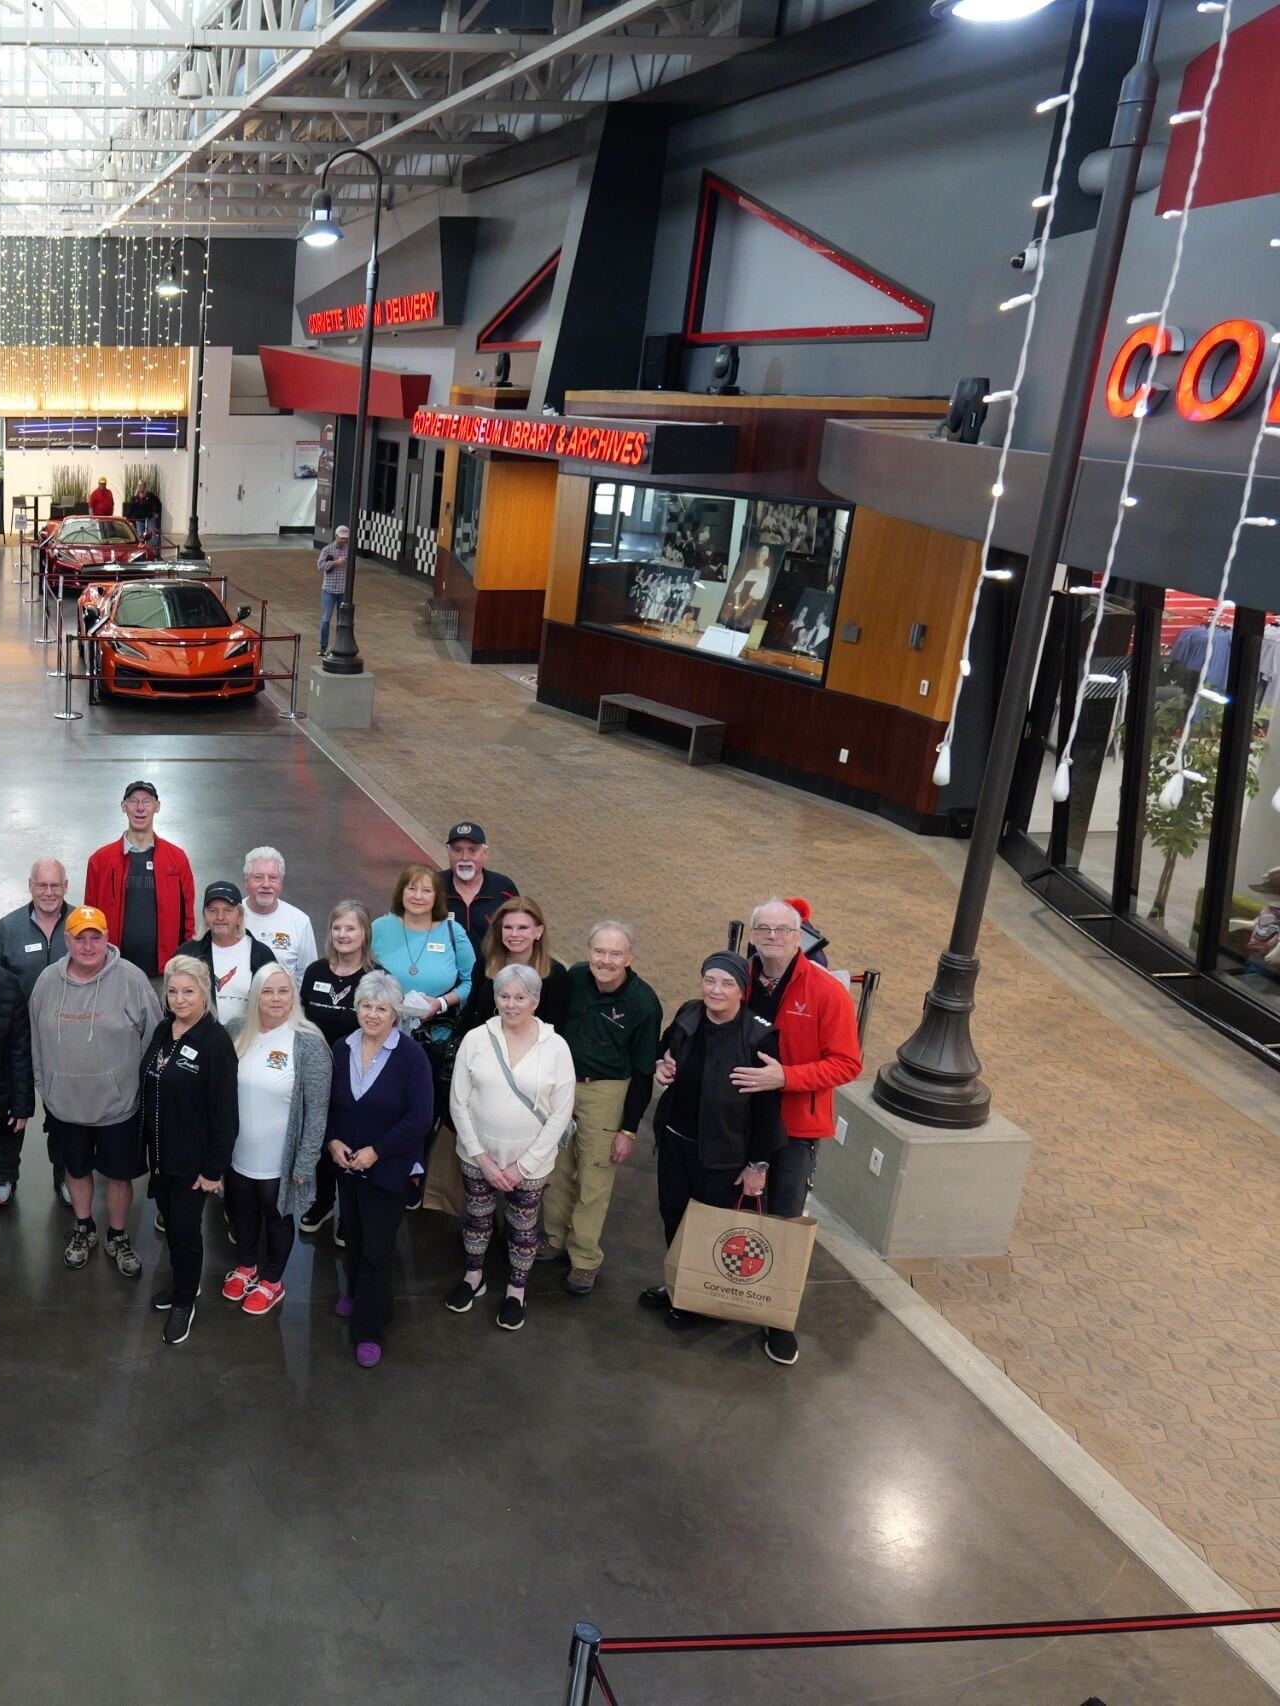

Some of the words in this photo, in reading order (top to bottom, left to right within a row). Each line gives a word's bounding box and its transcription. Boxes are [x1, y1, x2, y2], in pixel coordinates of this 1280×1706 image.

[308, 309, 344, 335] CORVETTE
[385, 291, 436, 325] DELIVERY
[1106, 318, 1280, 424] CO
[412, 411, 459, 439] CORVETTE
[459, 415, 502, 445] MUSEUM
[502, 419, 556, 451] LIBRARY
[556, 424, 566, 454] &
[569, 427, 645, 465] ARCHIVES
[80, 908, 95, 919] T
[719, 1230, 745, 1244] National
[747, 1230, 769, 1253] Corvette
[725, 1271, 754, 1283] Museum
[703, 1281, 745, 1297] Corvette
[746, 1291, 772, 1302] Store
